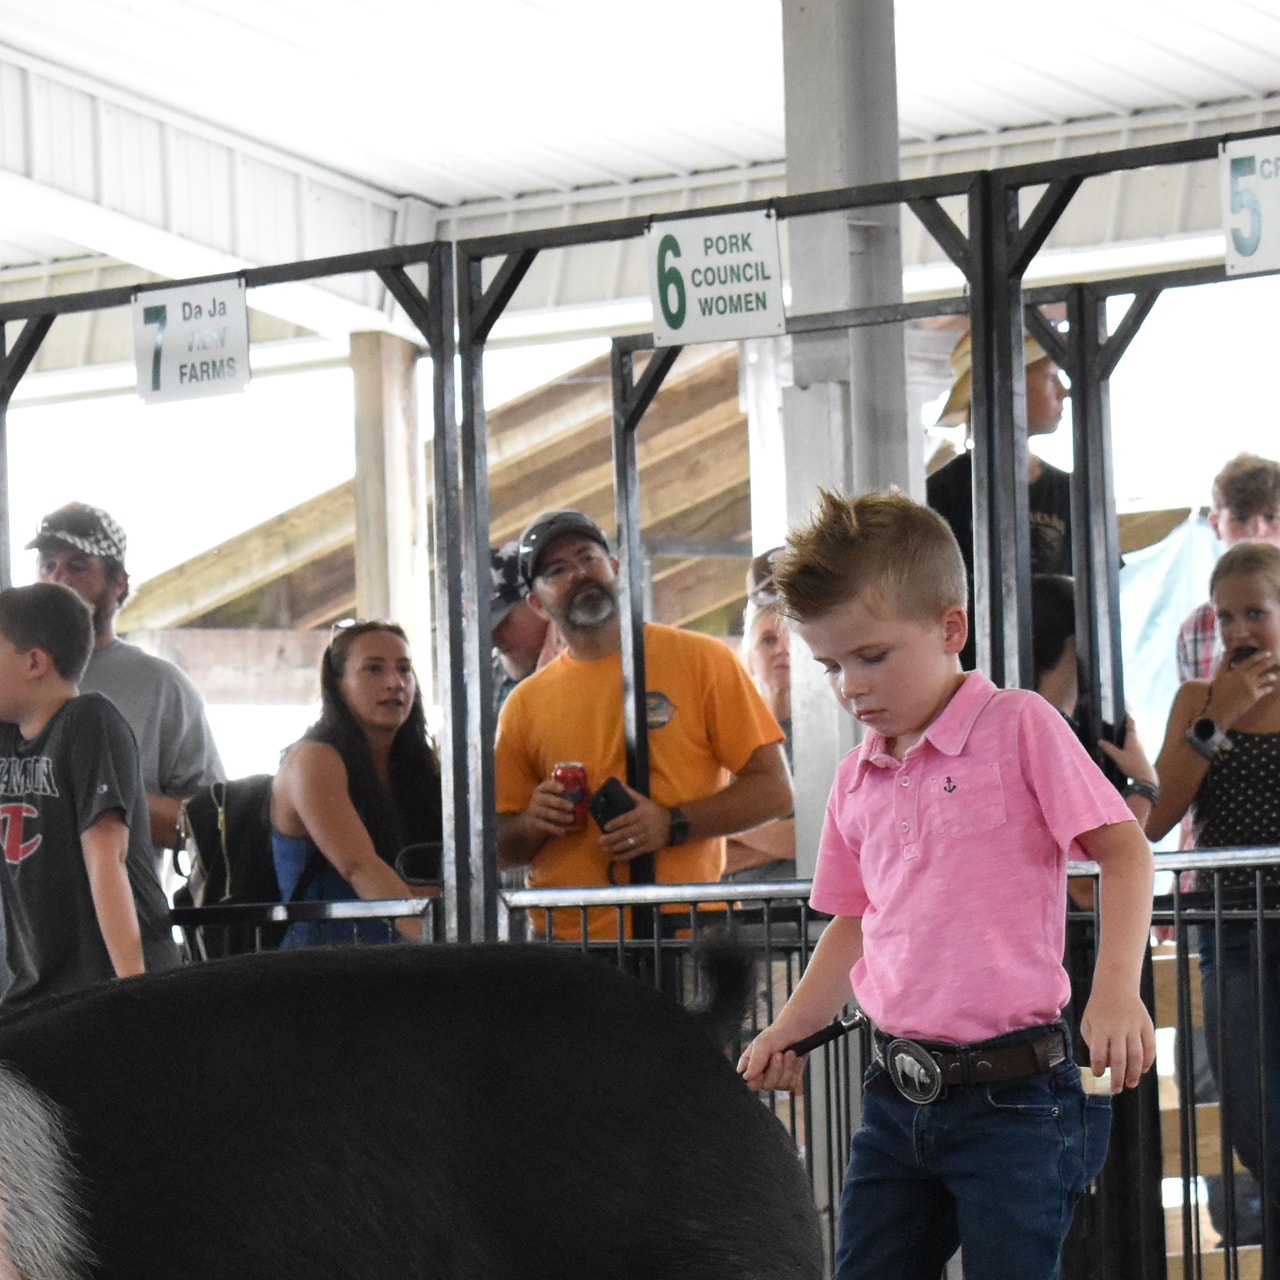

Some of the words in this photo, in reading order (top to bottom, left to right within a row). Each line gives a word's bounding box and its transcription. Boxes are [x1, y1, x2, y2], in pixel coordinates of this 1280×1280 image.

[1230, 155, 1262, 257] 5
[703, 232, 753, 256] PORK
[657, 234, 686, 330] 6
[691, 261, 771, 287] COUNCIL
[182, 301, 202, 321] Da
[208, 298, 227, 318] Ja
[698, 291, 767, 317] WOMEN
[143, 304, 167, 391] 7
[179, 357, 236, 383] FARMS
